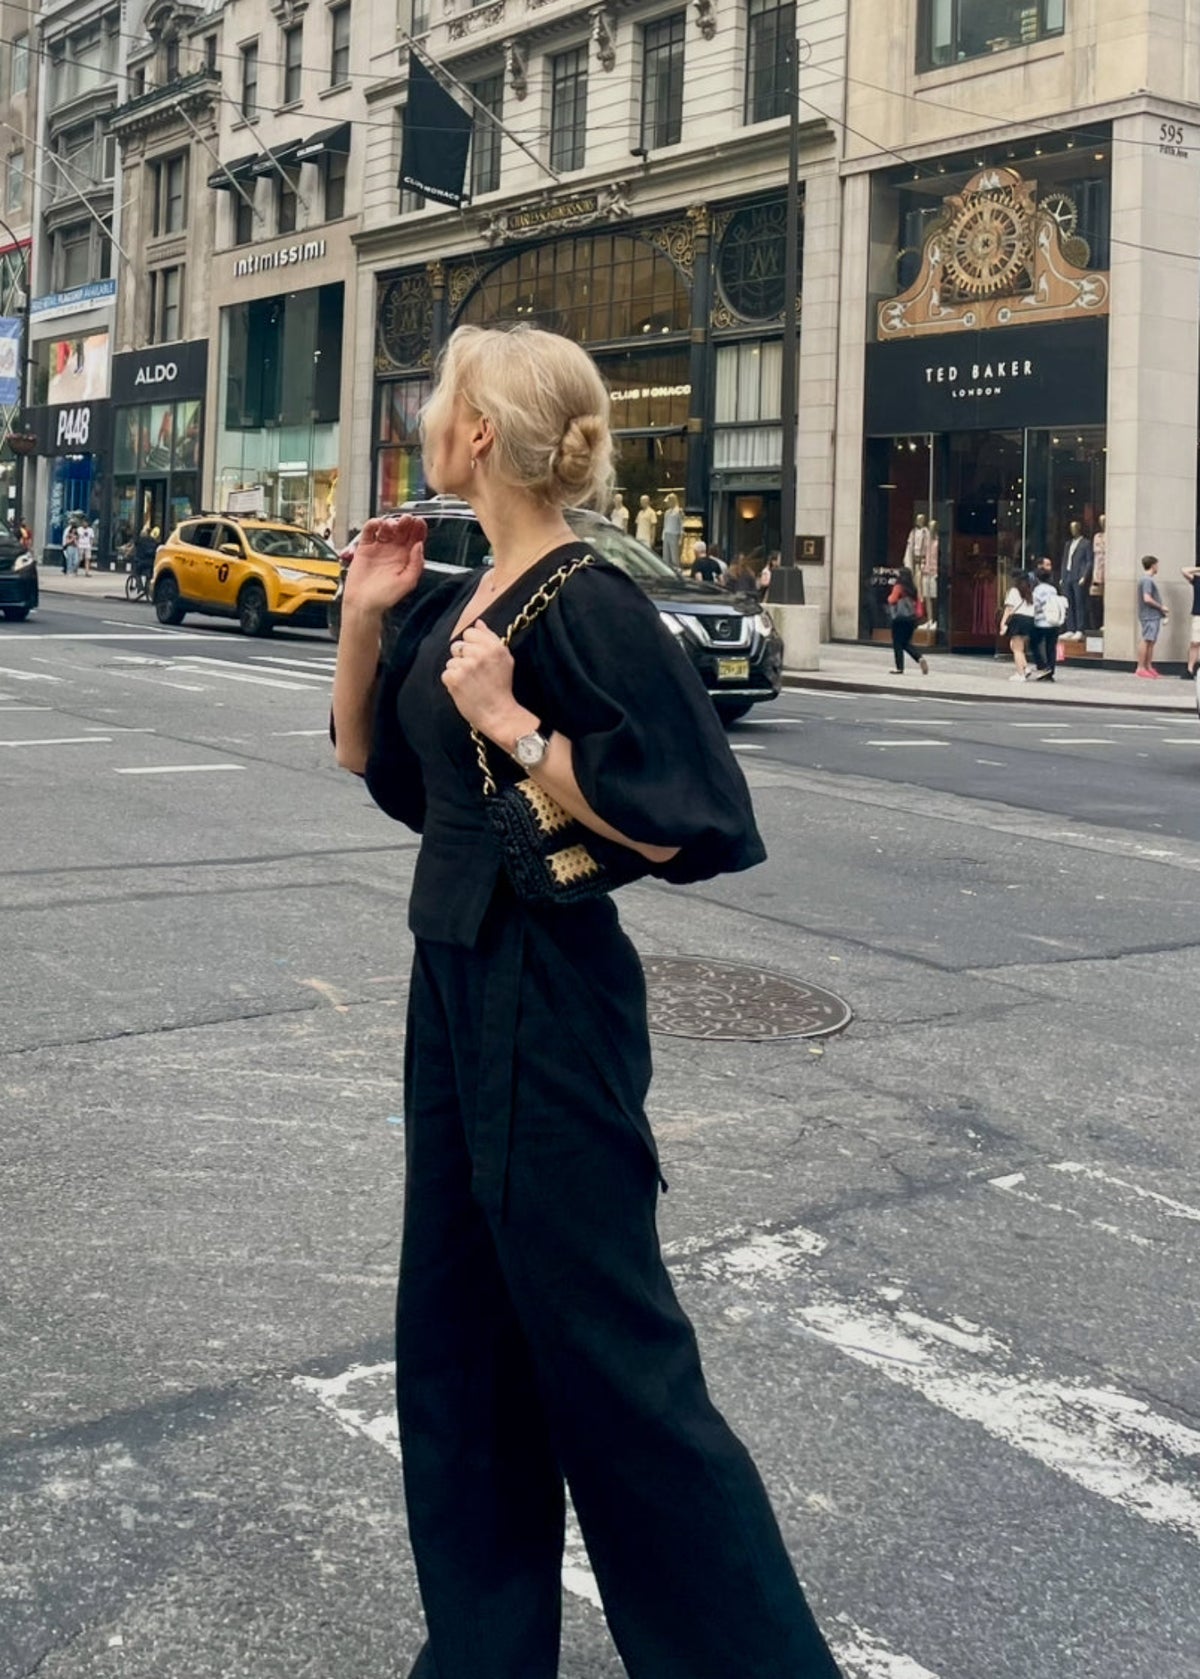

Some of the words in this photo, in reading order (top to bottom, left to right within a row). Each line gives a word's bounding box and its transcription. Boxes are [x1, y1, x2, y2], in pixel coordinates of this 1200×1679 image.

[1160, 123, 1184, 145] 595
[424, 186, 460, 201] MONACO
[233, 239, 326, 277] intimissimi
[135, 363, 178, 386] ALDO
[925, 366, 958, 382] TED
[972, 360, 1032, 380] BAKER
[610, 388, 640, 401] CLUB
[952, 387, 1001, 398] LONDON
[57, 408, 91, 446] P448
